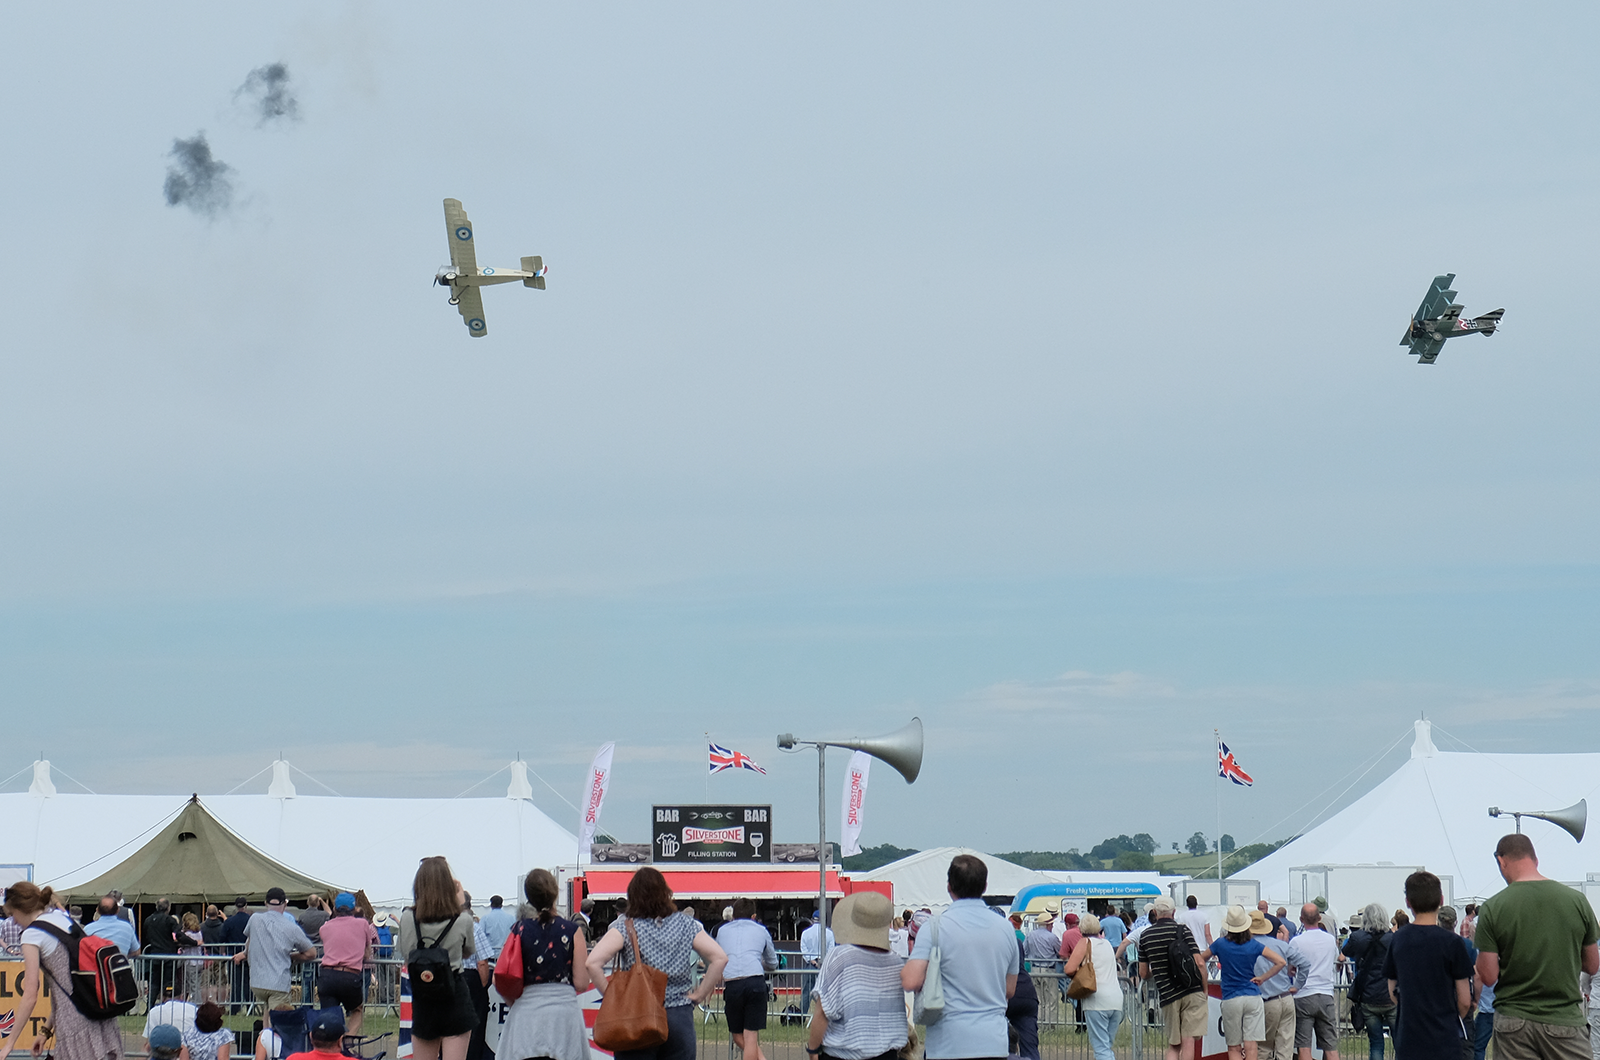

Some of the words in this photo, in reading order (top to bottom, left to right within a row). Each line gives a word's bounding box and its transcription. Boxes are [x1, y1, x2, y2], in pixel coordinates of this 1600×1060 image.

[586, 769, 605, 824] SILVERSTONE
[848, 771, 862, 825] SILVERSTONE
[656, 809, 680, 822] BAR
[744, 809, 768, 822] BAR
[685, 829, 742, 841] SILVERSTONE
[1066, 887, 1088, 895] Freshly
[1088, 887, 1115, 895] Whipped
